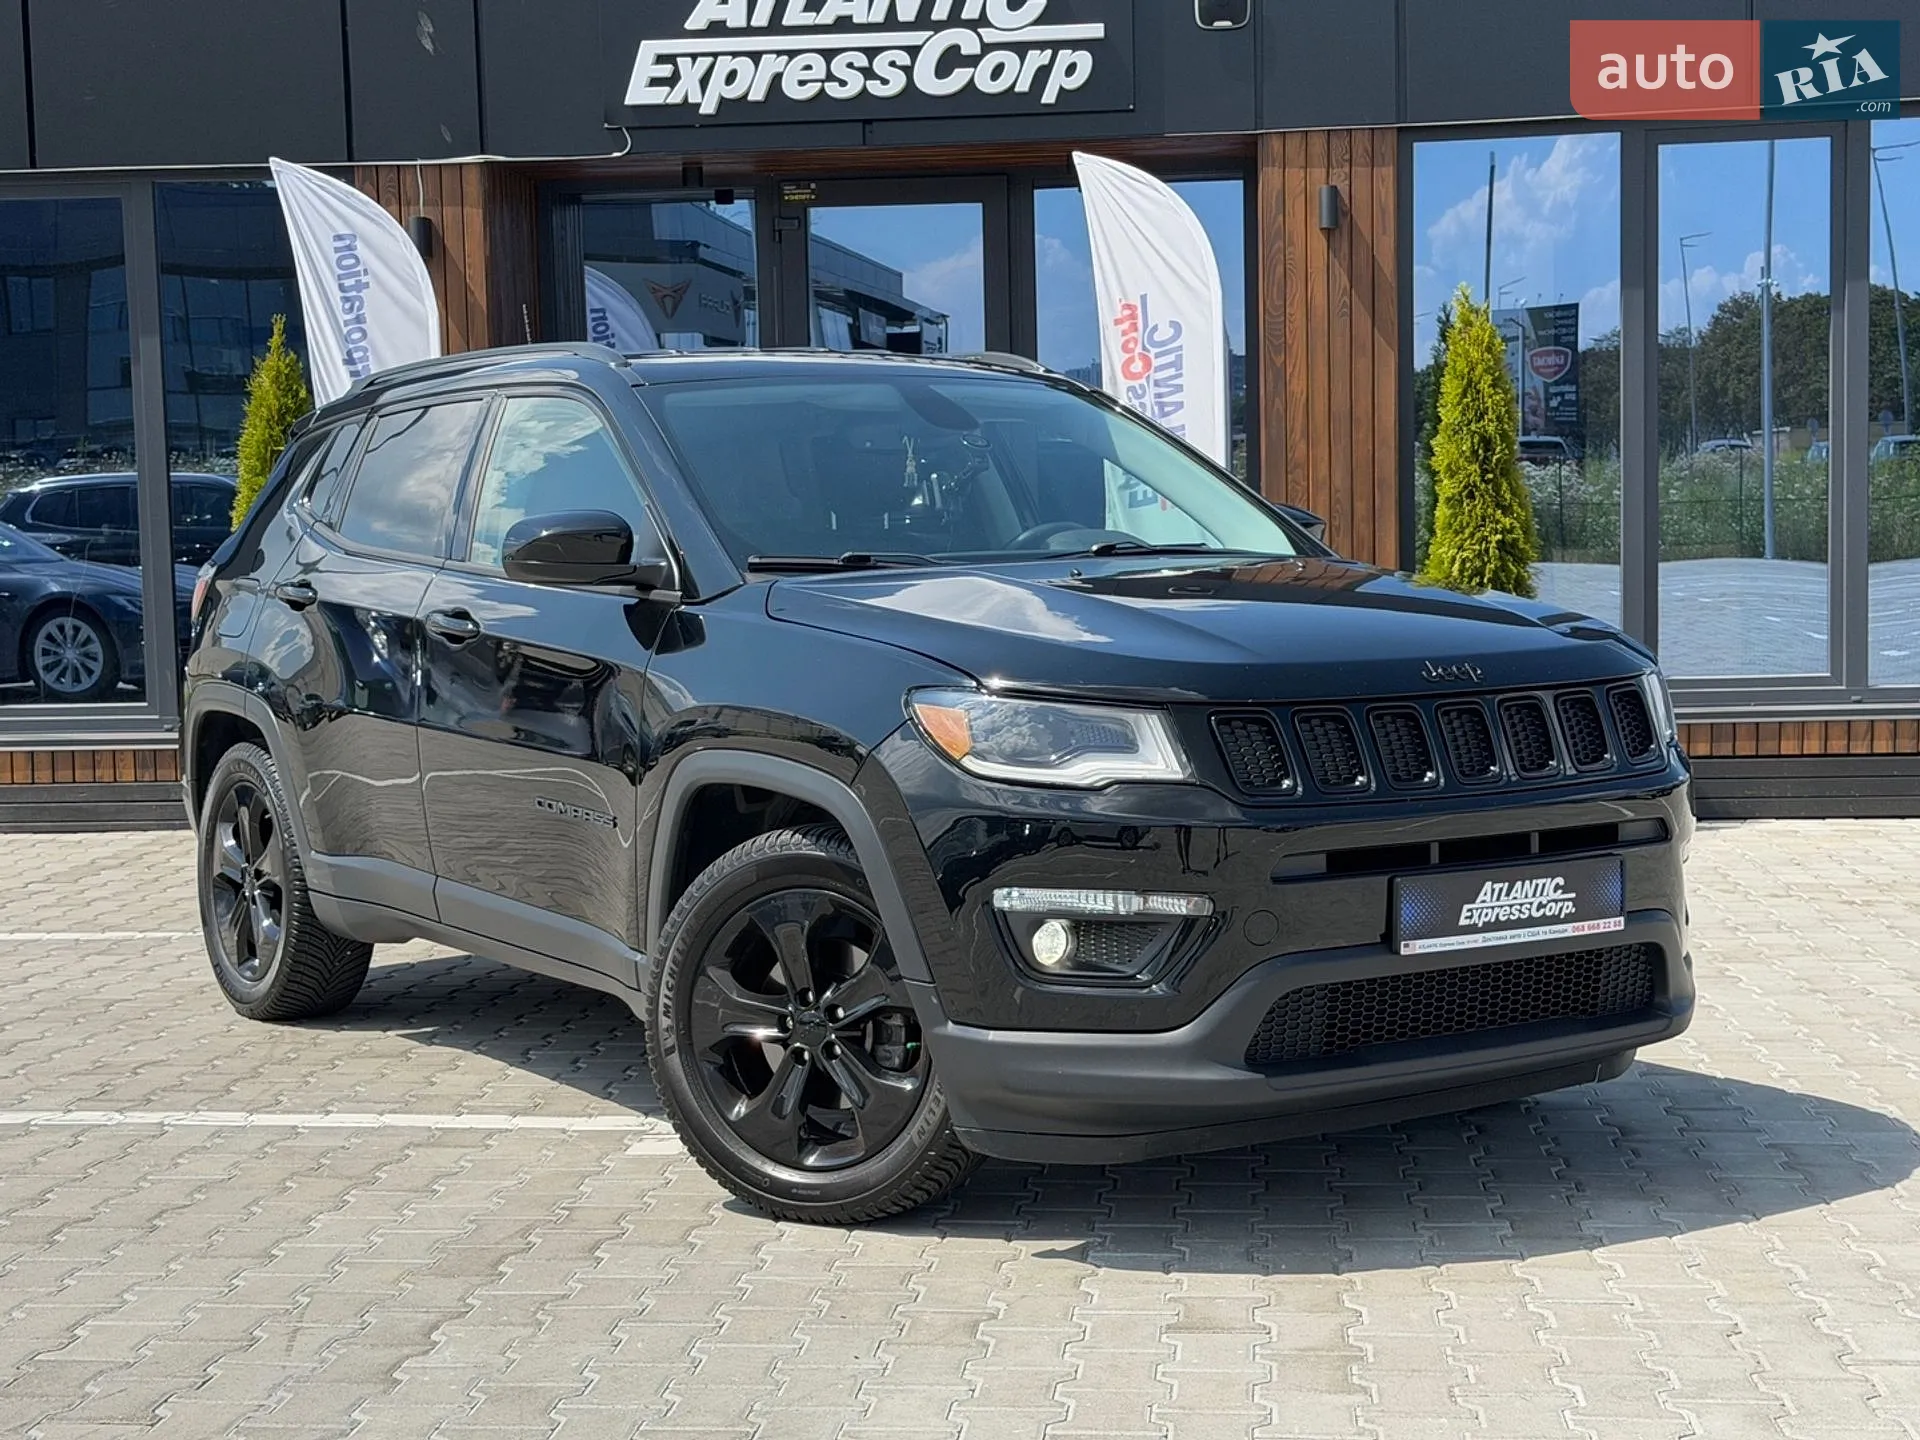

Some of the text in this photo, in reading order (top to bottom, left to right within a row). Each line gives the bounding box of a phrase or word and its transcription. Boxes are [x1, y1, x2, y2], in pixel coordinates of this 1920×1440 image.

[624, 27, 1093, 115] ExpressCorp
[1421, 660, 1484, 683] Jeep
[1475, 876, 1565, 904] ATLANTIC
[1458, 897, 1576, 927] ExpressCorp.
[1602, 921, 1611, 929] 22
